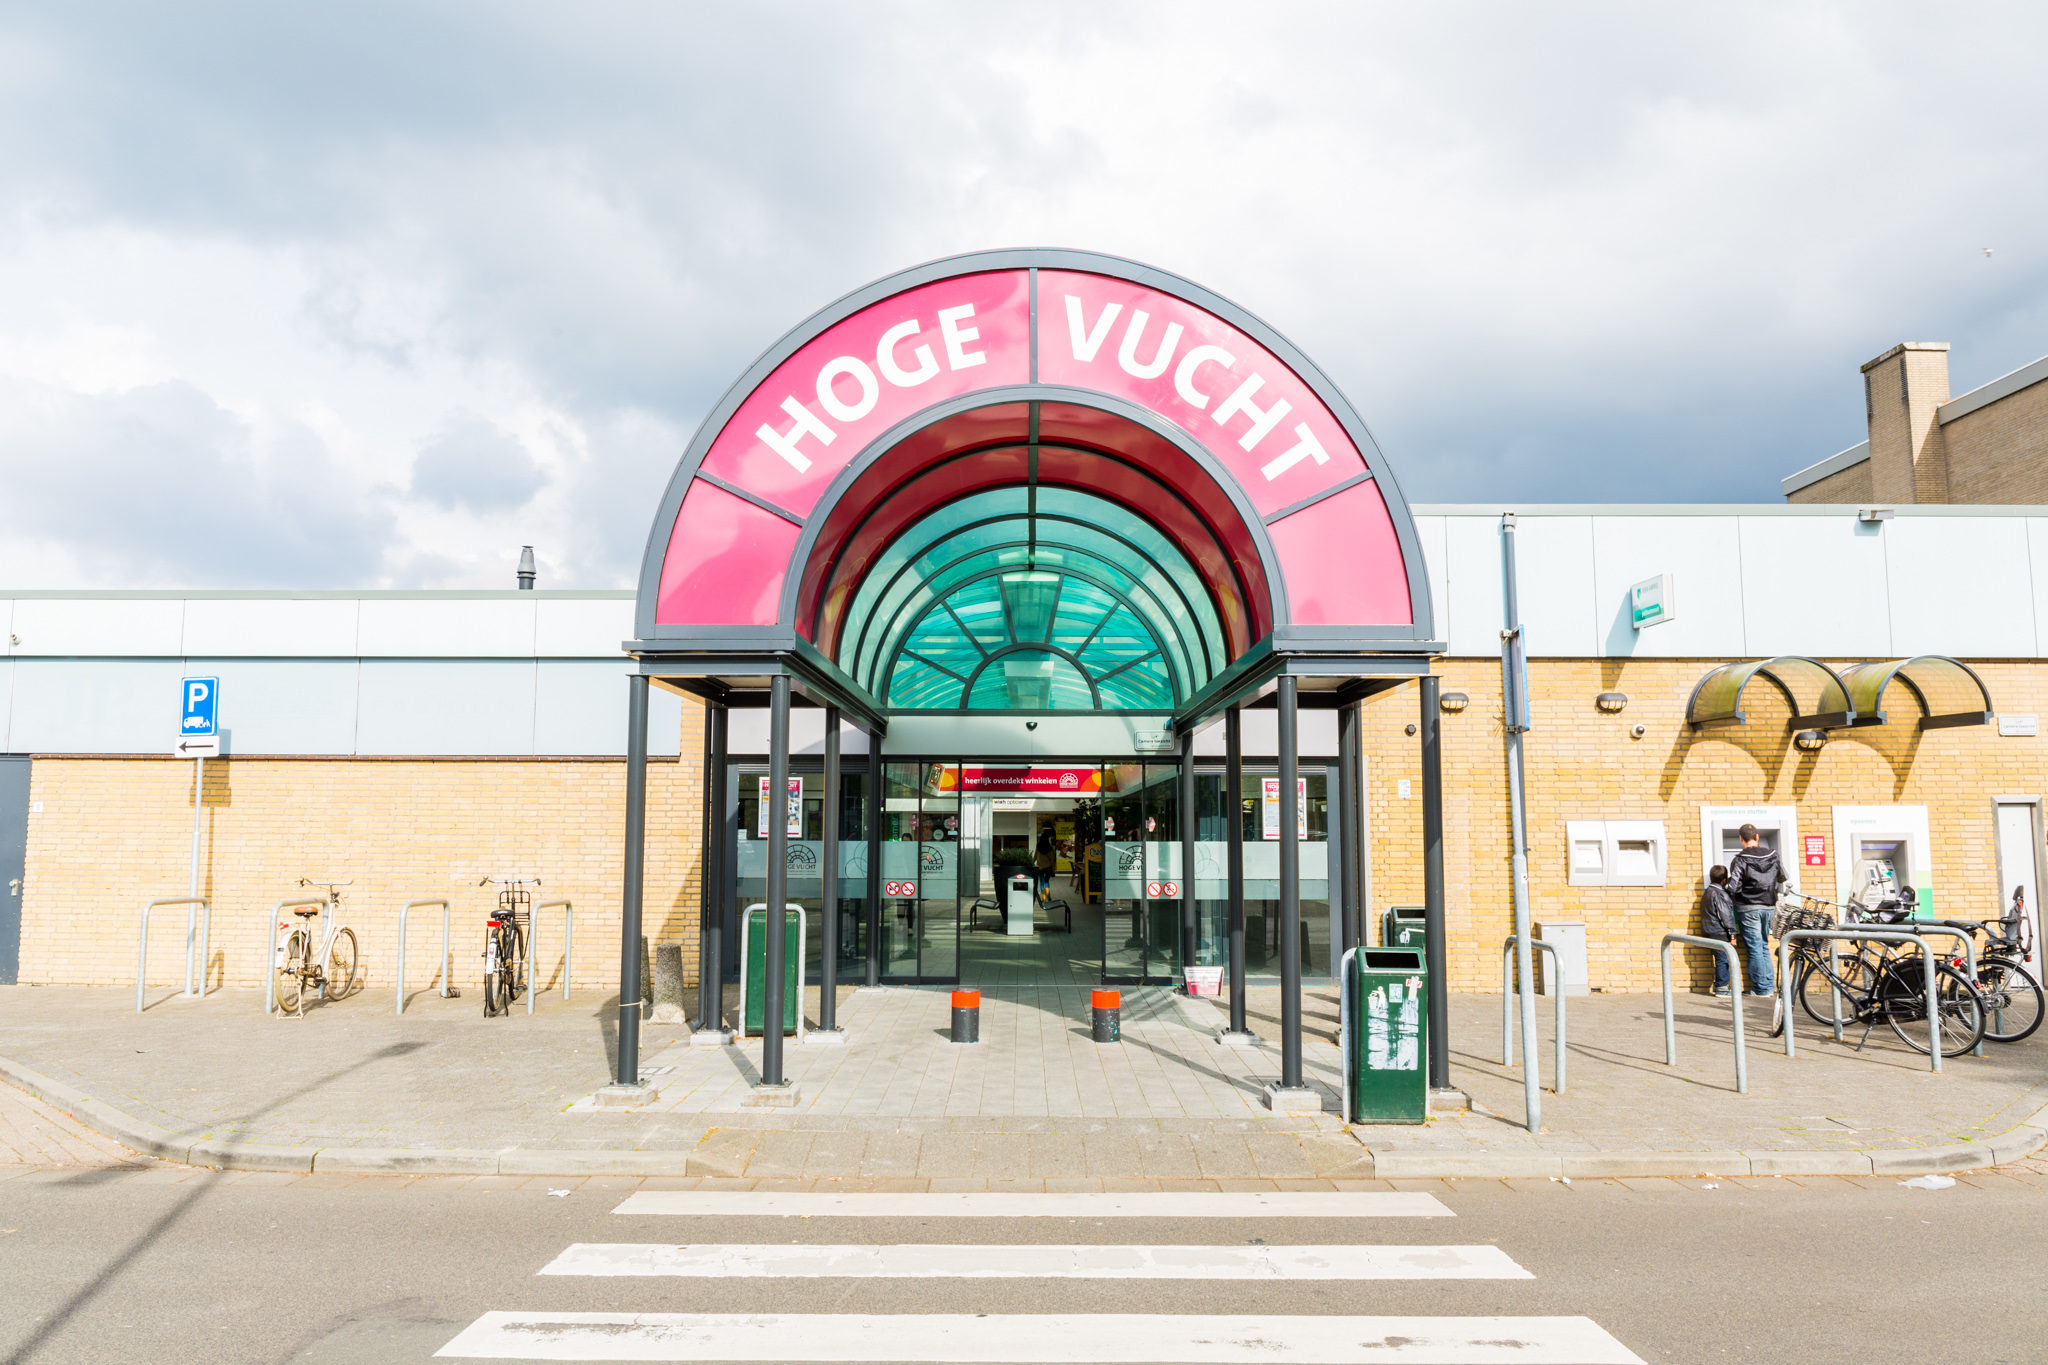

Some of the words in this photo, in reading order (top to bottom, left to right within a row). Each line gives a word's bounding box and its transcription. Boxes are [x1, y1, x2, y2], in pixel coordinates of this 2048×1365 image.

[755, 302, 986, 475] HOGE
[1064, 294, 1330, 482] VUCHT
[188, 683, 208, 712] P
[964, 777, 991, 786] heerlijk
[993, 777, 1023, 785] overdekt
[1025, 777, 1057, 785] winkelen
